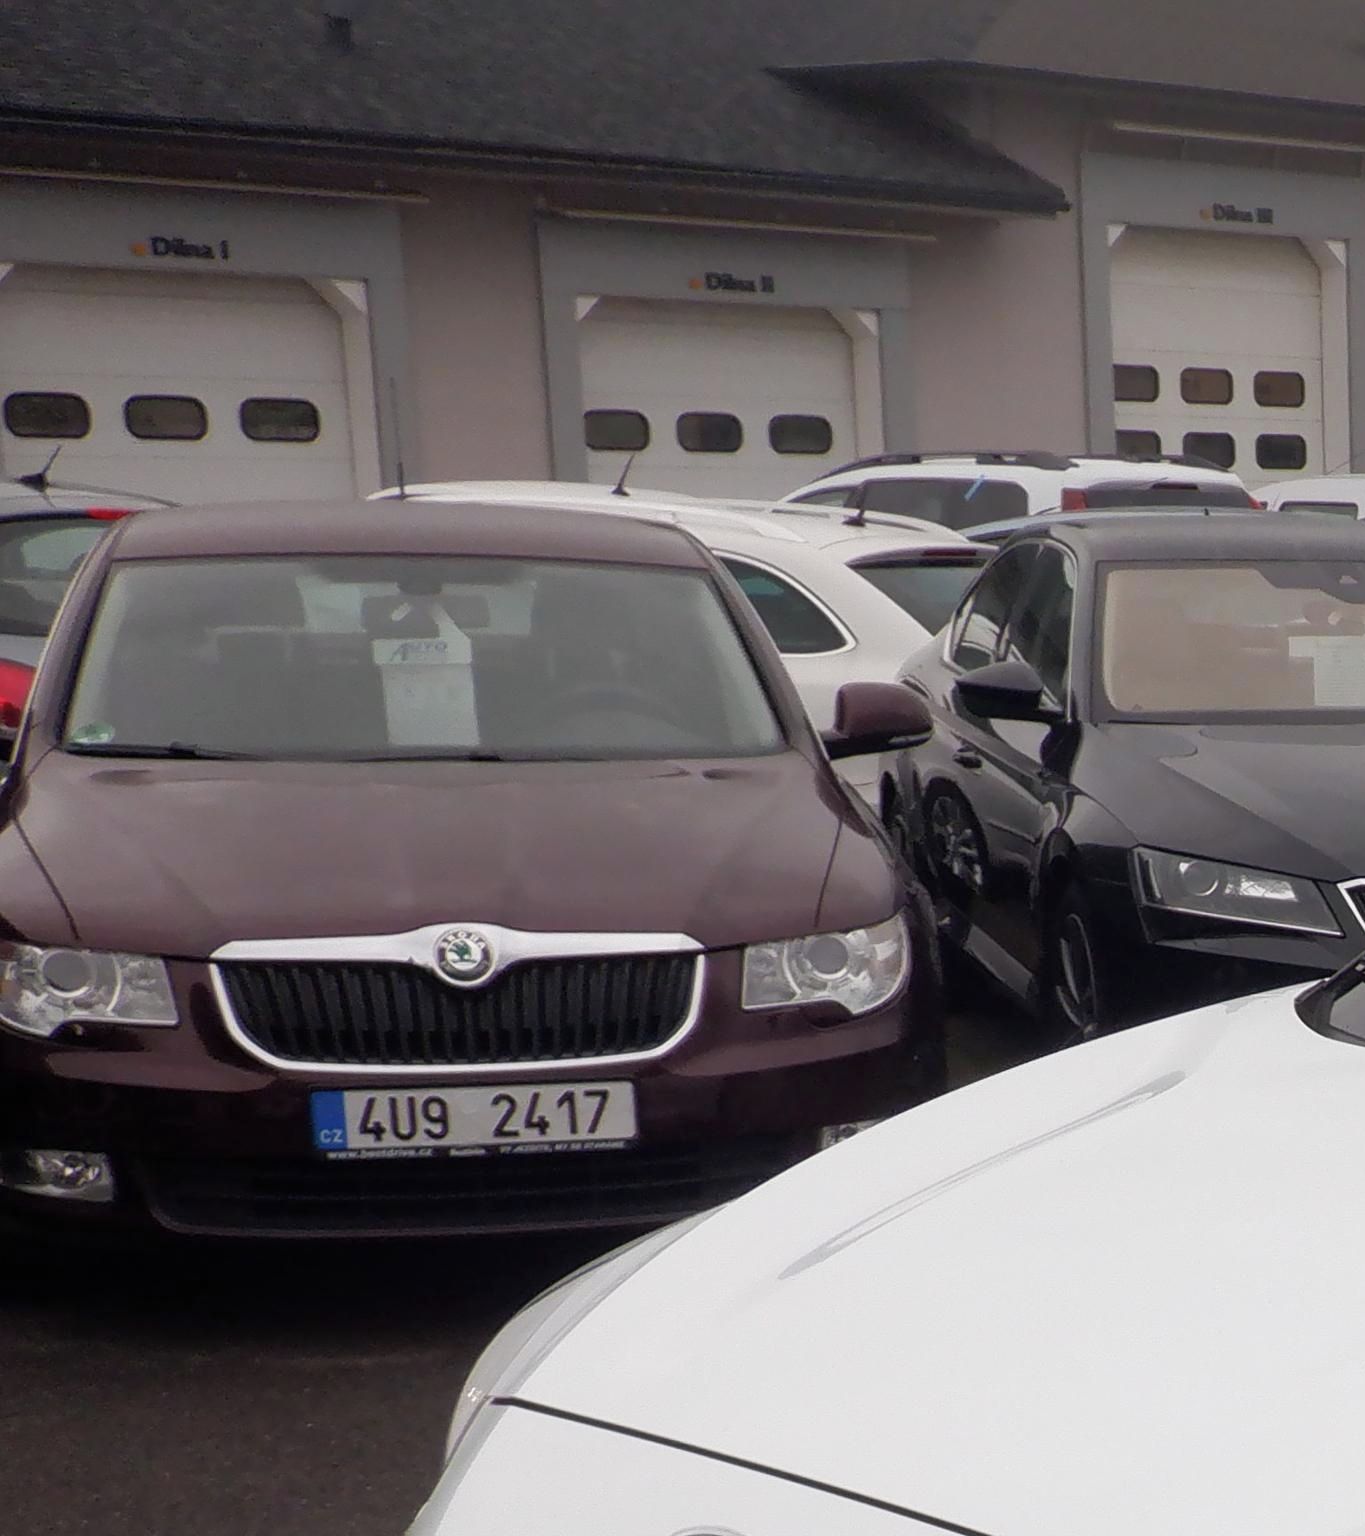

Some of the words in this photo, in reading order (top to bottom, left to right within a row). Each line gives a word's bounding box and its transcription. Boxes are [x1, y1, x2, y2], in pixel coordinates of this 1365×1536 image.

[358, 1094, 449, 1142] 4U9
[490, 1088, 610, 1138] 2417
[319, 1129, 344, 1144] CZ
